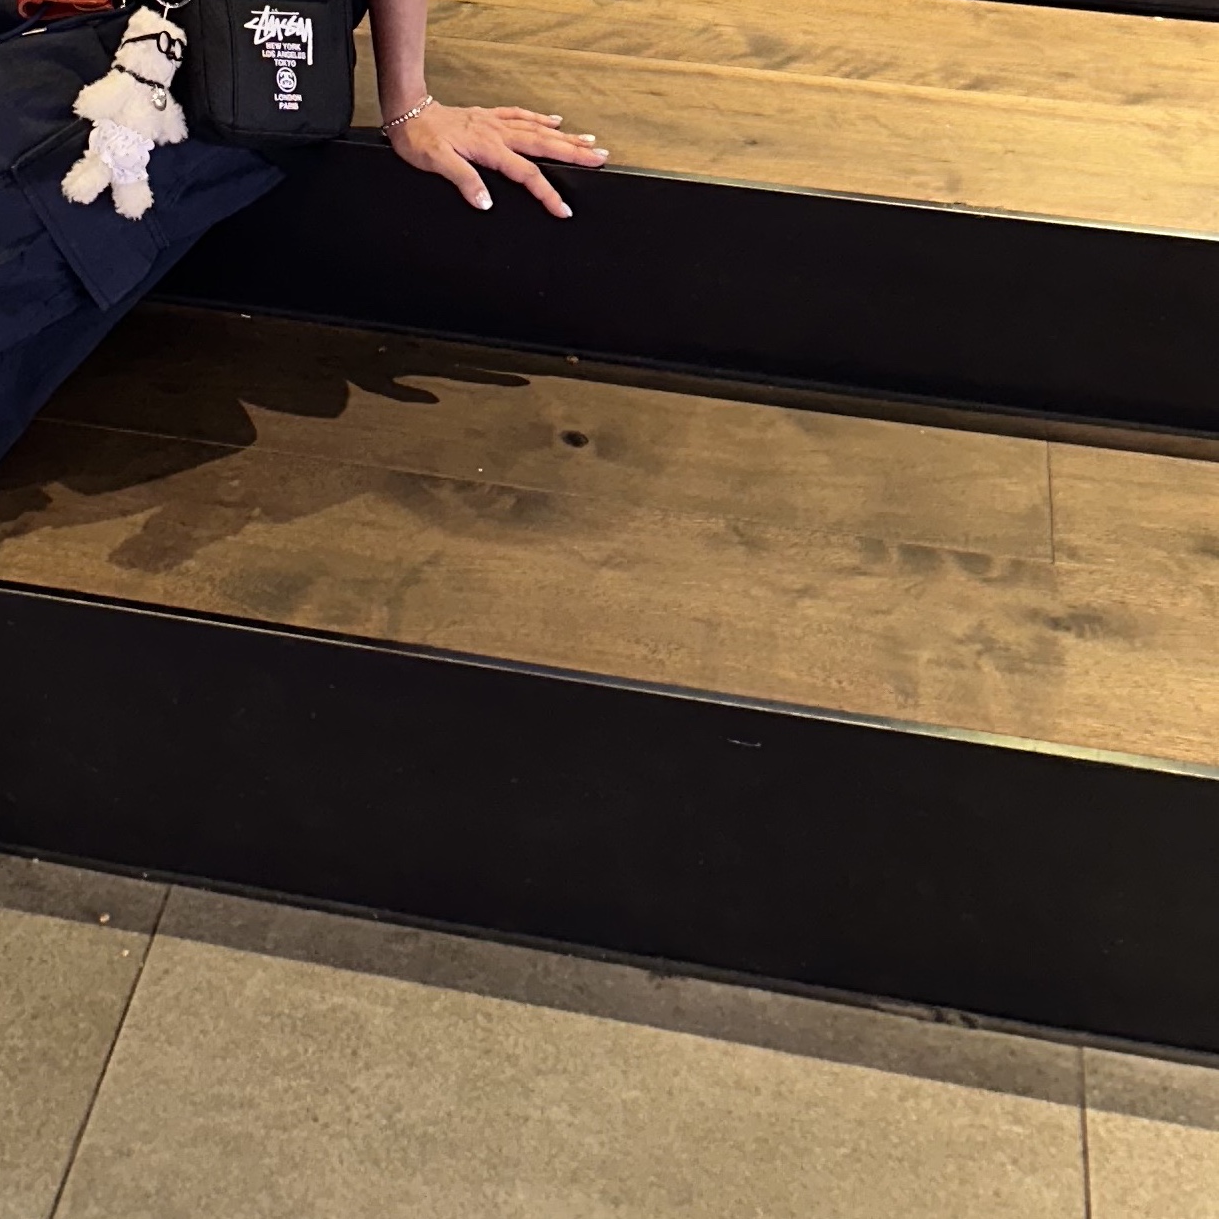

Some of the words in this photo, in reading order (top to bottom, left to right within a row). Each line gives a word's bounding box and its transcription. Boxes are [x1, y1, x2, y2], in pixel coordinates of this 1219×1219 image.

[266, 42, 281, 50] NEW
[282, 42, 301, 51] YORK
[262, 50, 275, 59] LOS
[277, 50, 306, 60] ANGELES
[274, 59, 296, 67] TOKYO
[274, 93, 302, 102] LONDON
[279, 102, 299, 110] PARIS
